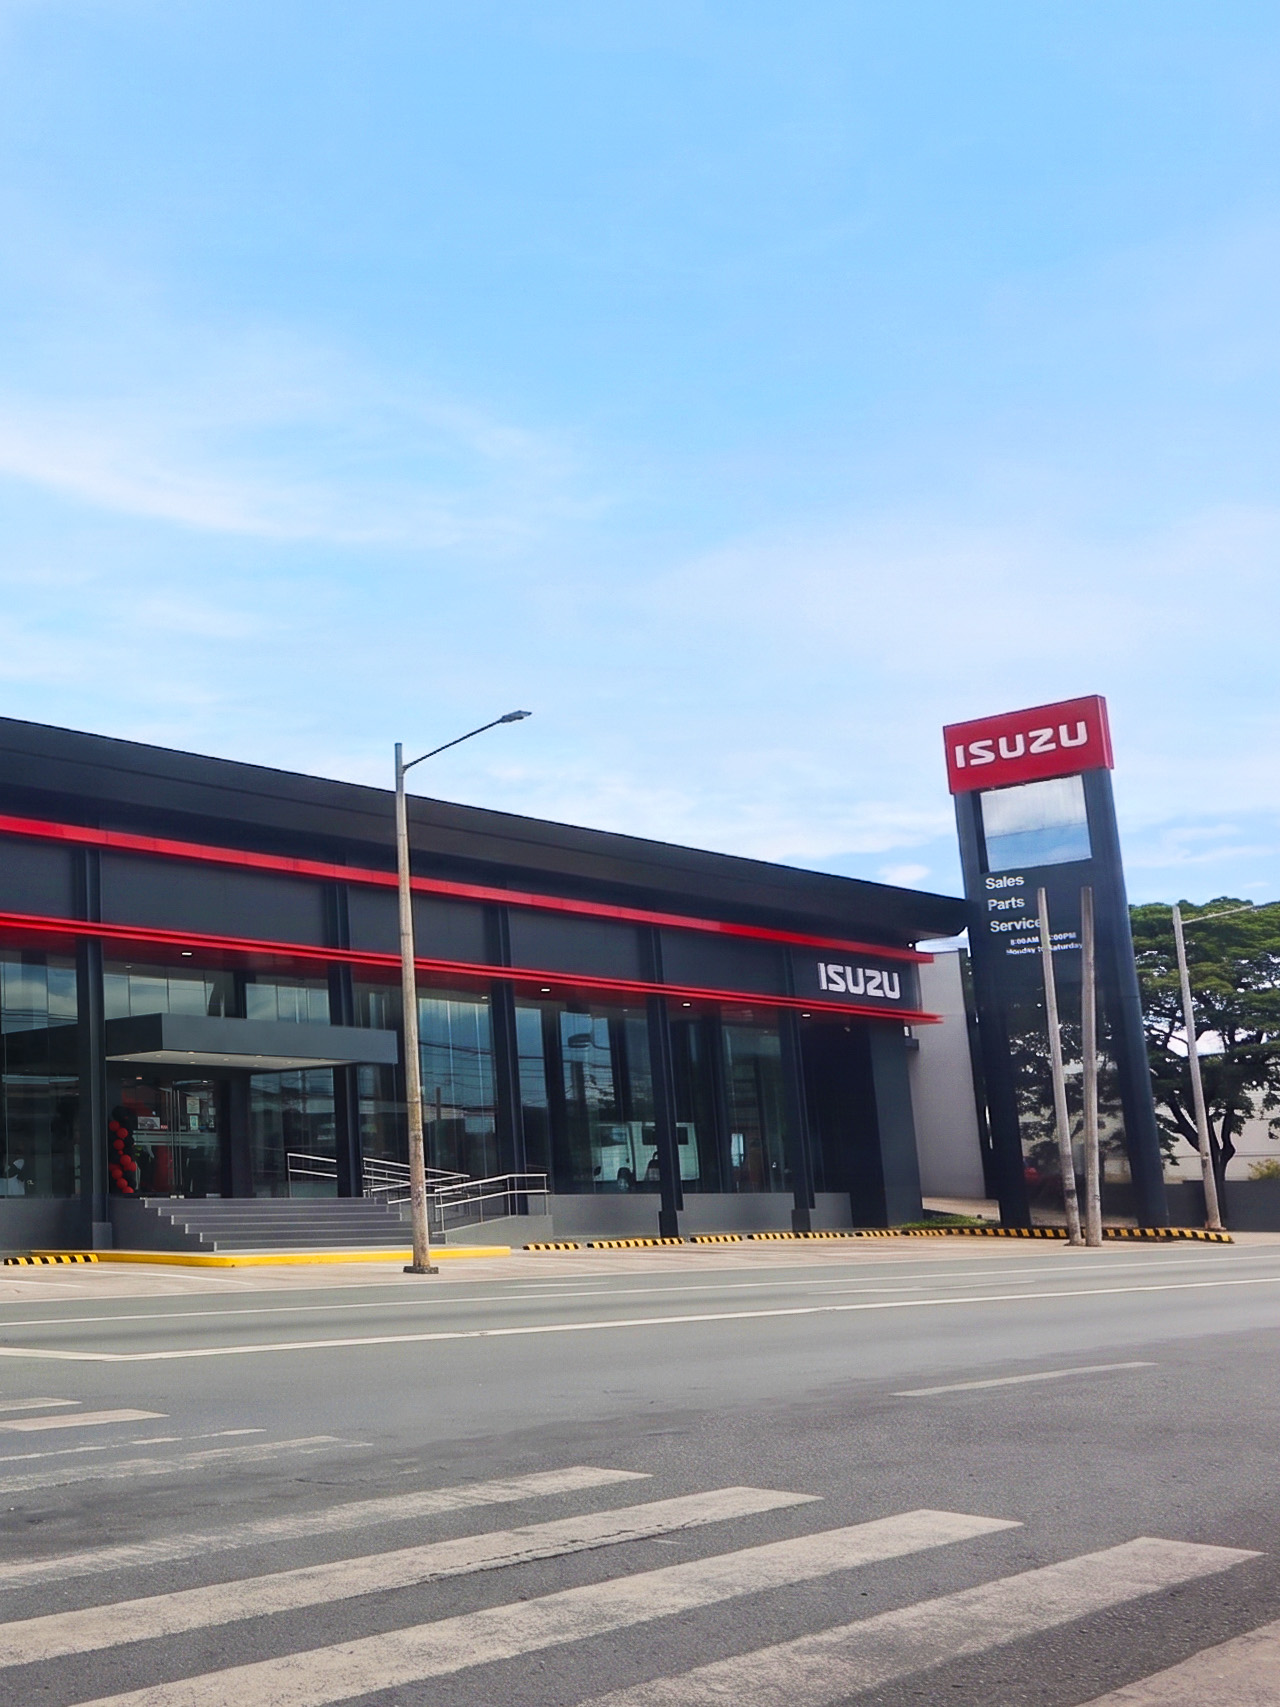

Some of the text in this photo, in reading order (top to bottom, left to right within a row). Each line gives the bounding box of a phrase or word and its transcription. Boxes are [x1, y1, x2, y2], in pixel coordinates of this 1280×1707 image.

[954, 720, 1089, 769] ISUZU
[985, 876, 1025, 890] Sales
[987, 897, 1026, 912] Parts
[1006, 947, 1036, 956] Monday
[817, 962, 901, 1000] ISUZU
